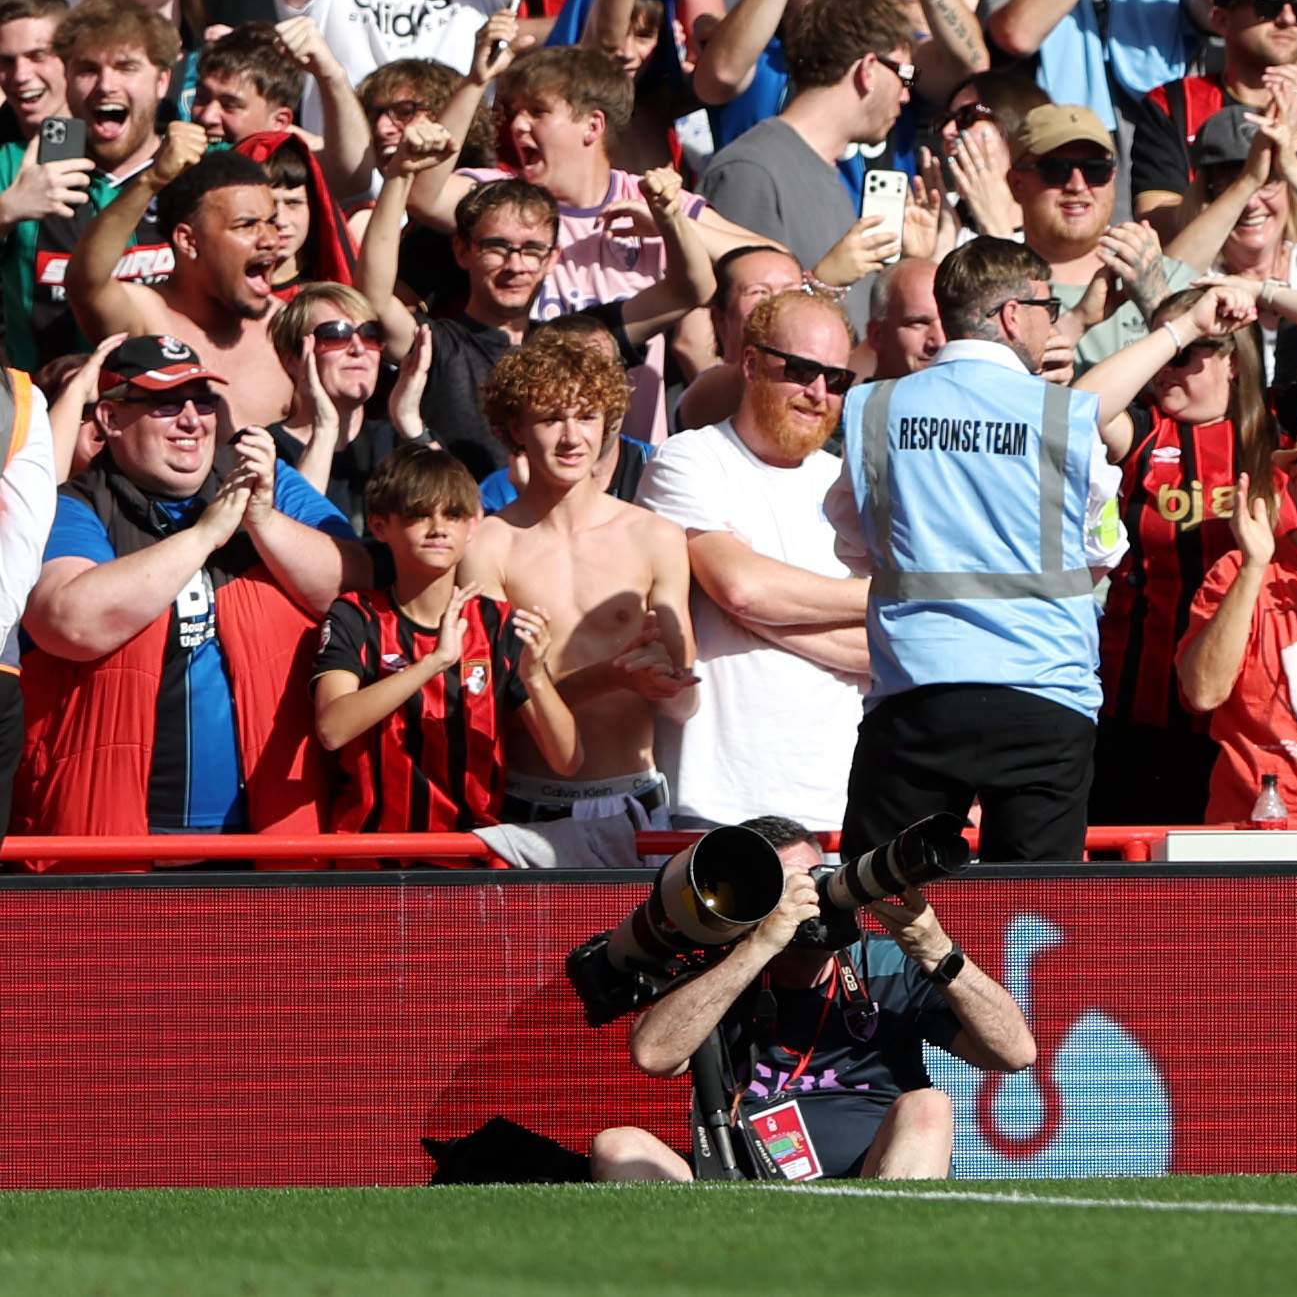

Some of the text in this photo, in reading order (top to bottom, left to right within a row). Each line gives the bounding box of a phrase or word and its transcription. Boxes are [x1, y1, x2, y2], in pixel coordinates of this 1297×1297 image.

[899, 416, 1028, 456] RESPONSE TEAM
[1157, 481, 1236, 532] bj8
[541, 785, 613, 799] Calvin Klein
